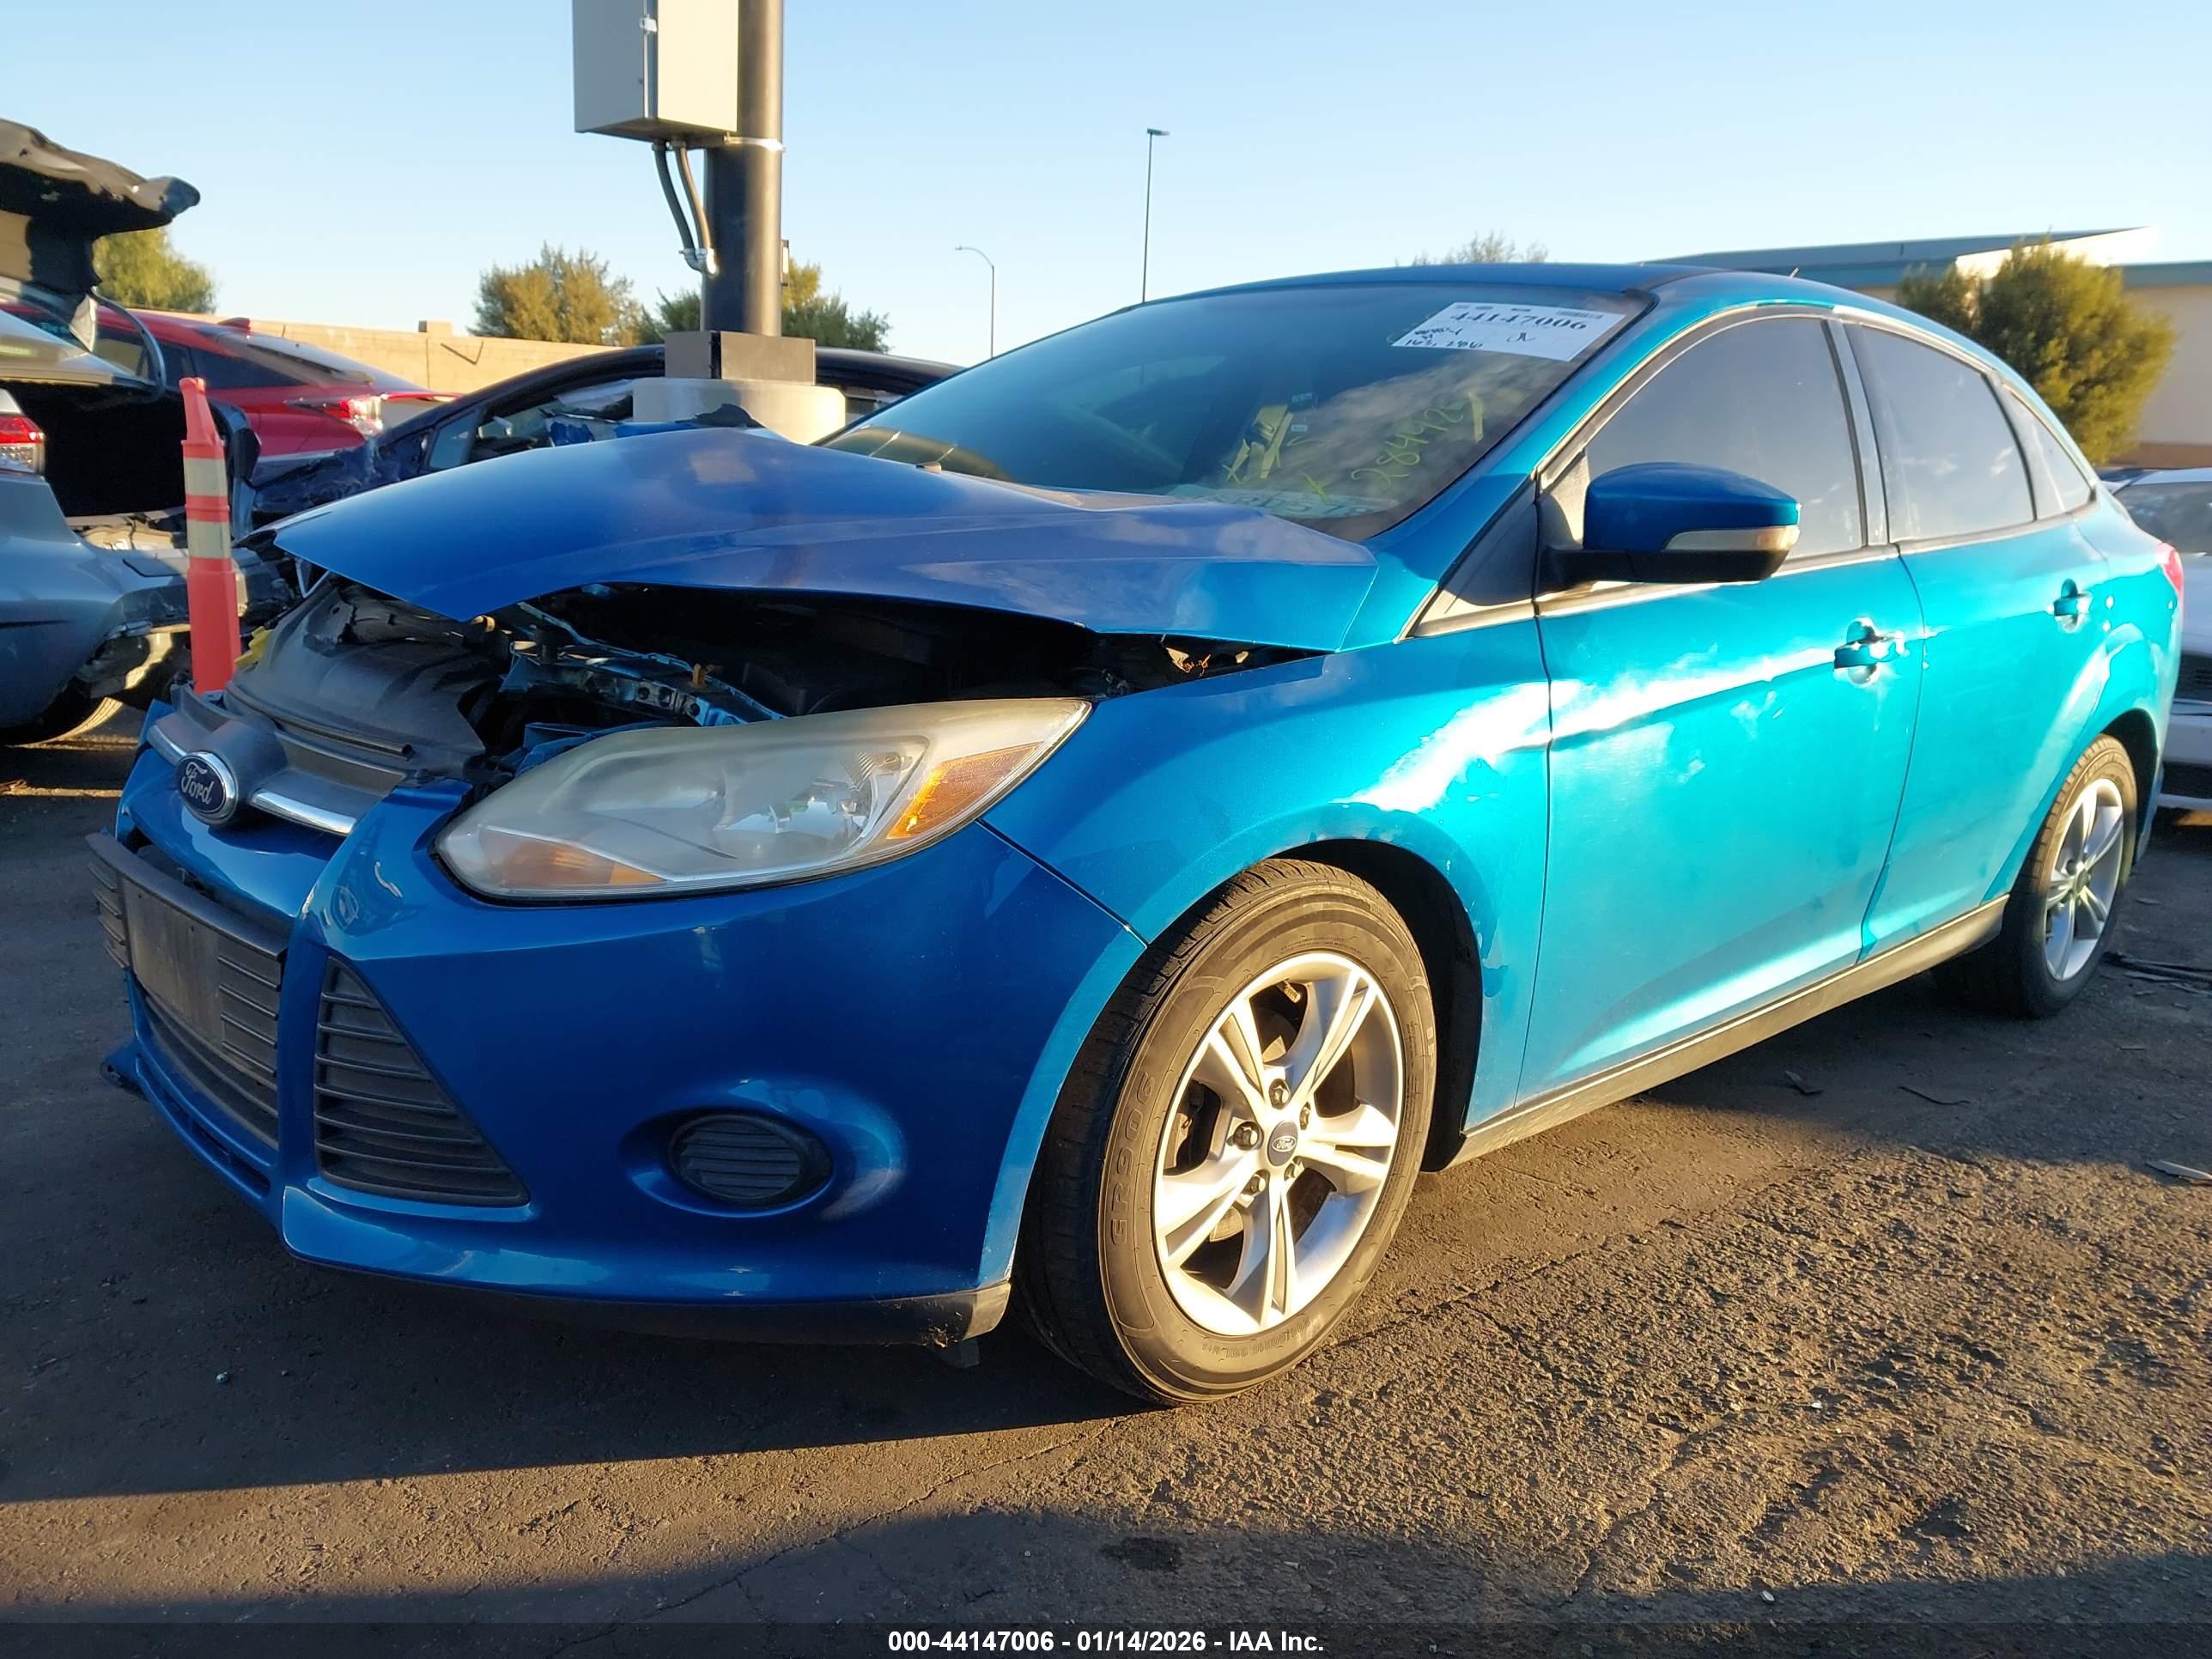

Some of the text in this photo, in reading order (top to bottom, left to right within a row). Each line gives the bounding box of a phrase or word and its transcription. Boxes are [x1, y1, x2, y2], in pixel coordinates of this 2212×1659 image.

[1450, 311, 1587, 330] 44147006
[180, 761, 215, 805] Ford
[1110, 1072, 1156, 1245] GR906
